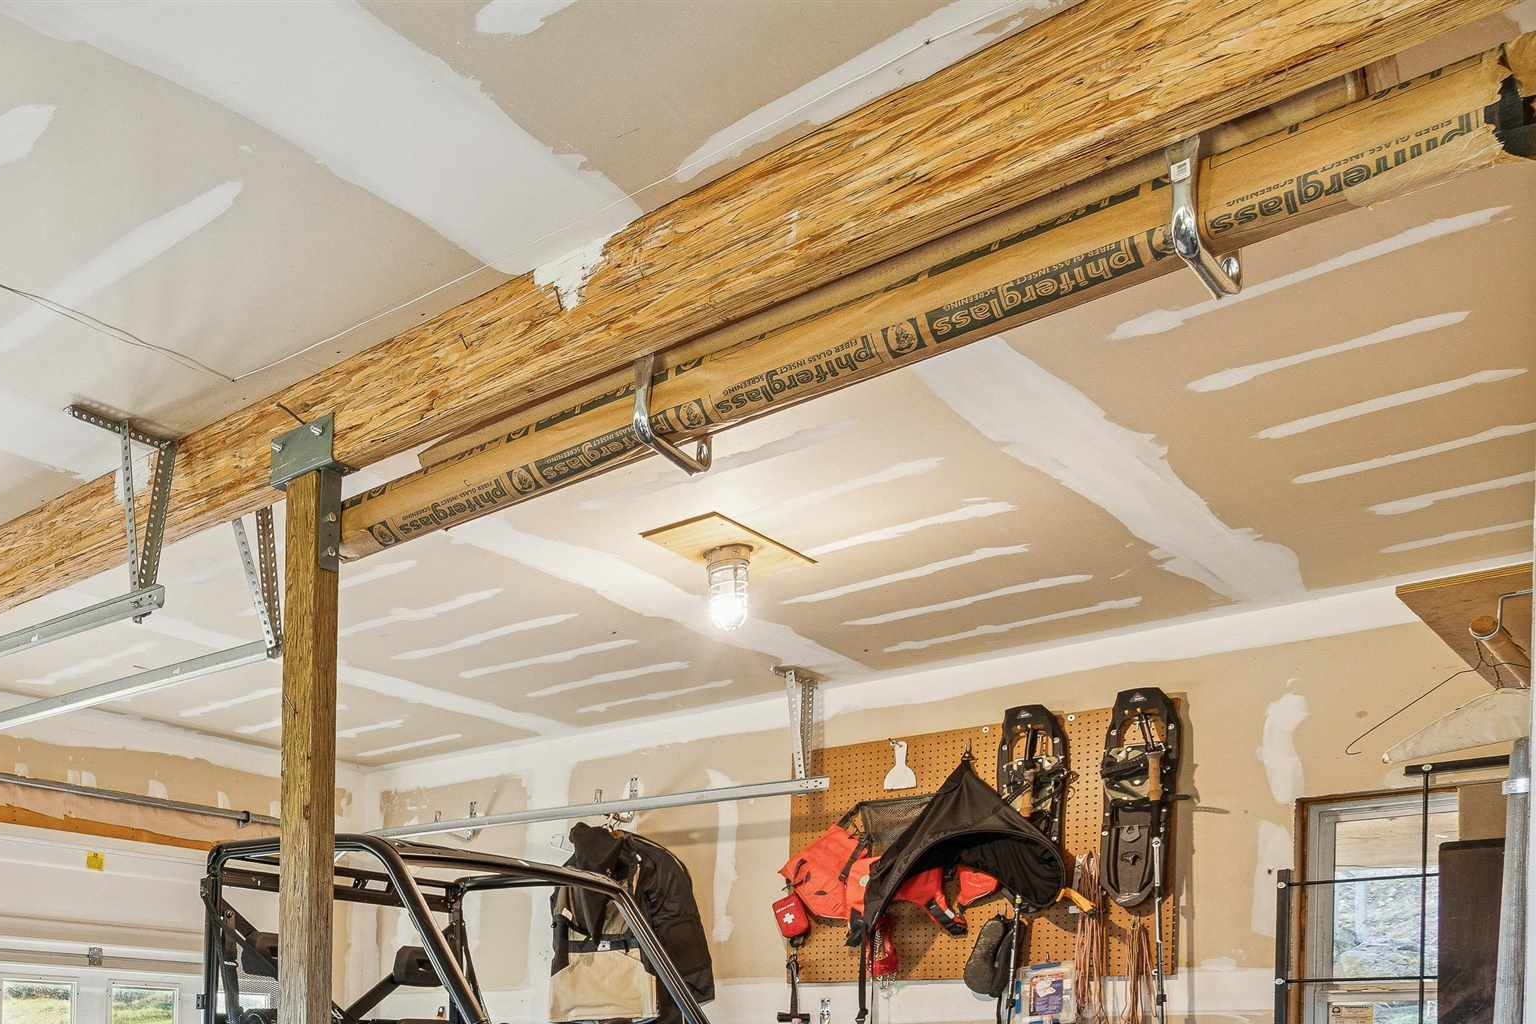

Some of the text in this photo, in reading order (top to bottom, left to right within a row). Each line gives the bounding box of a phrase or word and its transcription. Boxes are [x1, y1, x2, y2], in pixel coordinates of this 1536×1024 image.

[933, 237, 1136, 336] phiferglass
[717, 335, 876, 414] phiferglass
[399, 478, 508, 536] phiferglass
